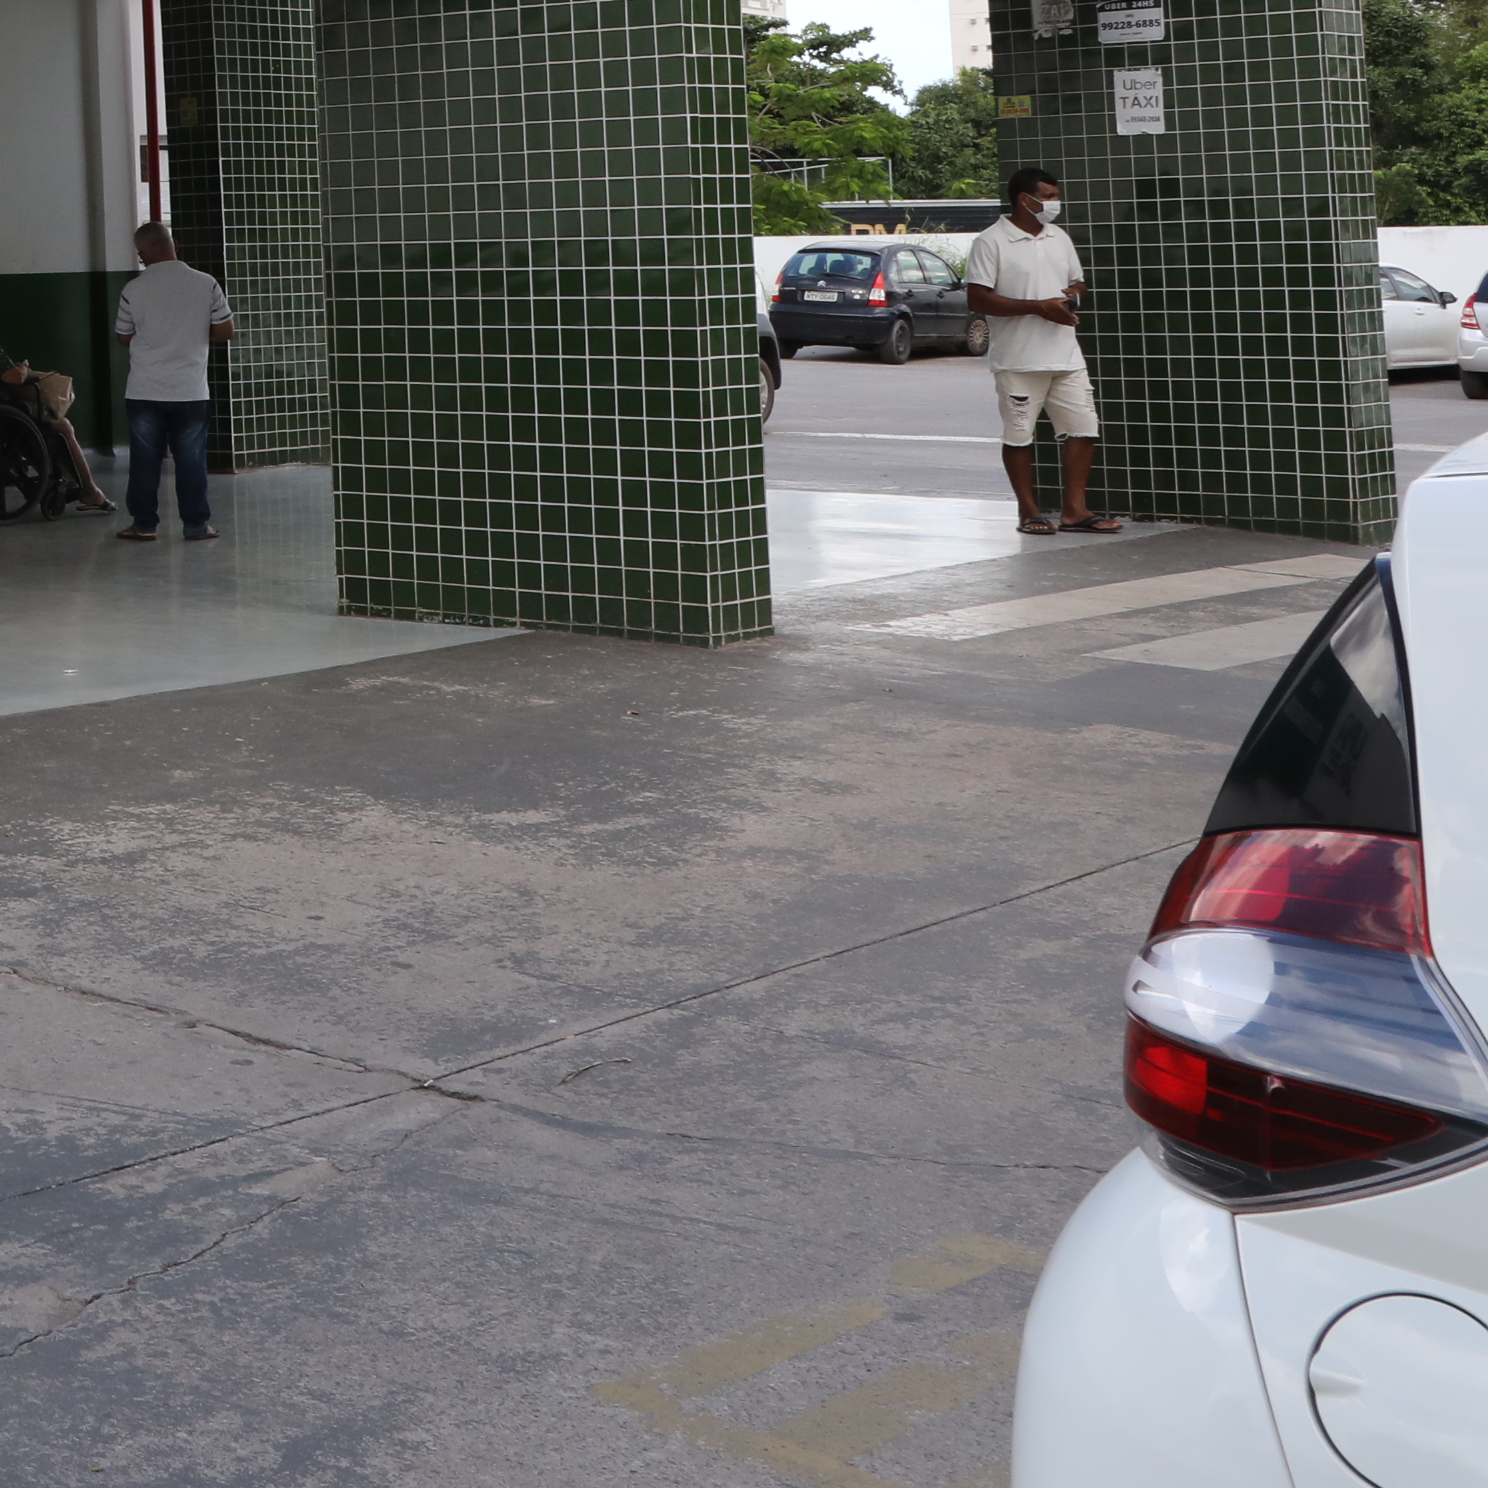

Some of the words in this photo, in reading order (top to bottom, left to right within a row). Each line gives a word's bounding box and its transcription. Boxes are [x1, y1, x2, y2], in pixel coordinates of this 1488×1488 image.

[1104, 2, 1127, 10] UBER
[1131, 0, 1155, 8] 24HS
[1101, 18, 1161, 31] 99228-6885
[1122, 79, 1158, 91] Uber
[1119, 93, 1159, 109] TÁXI
